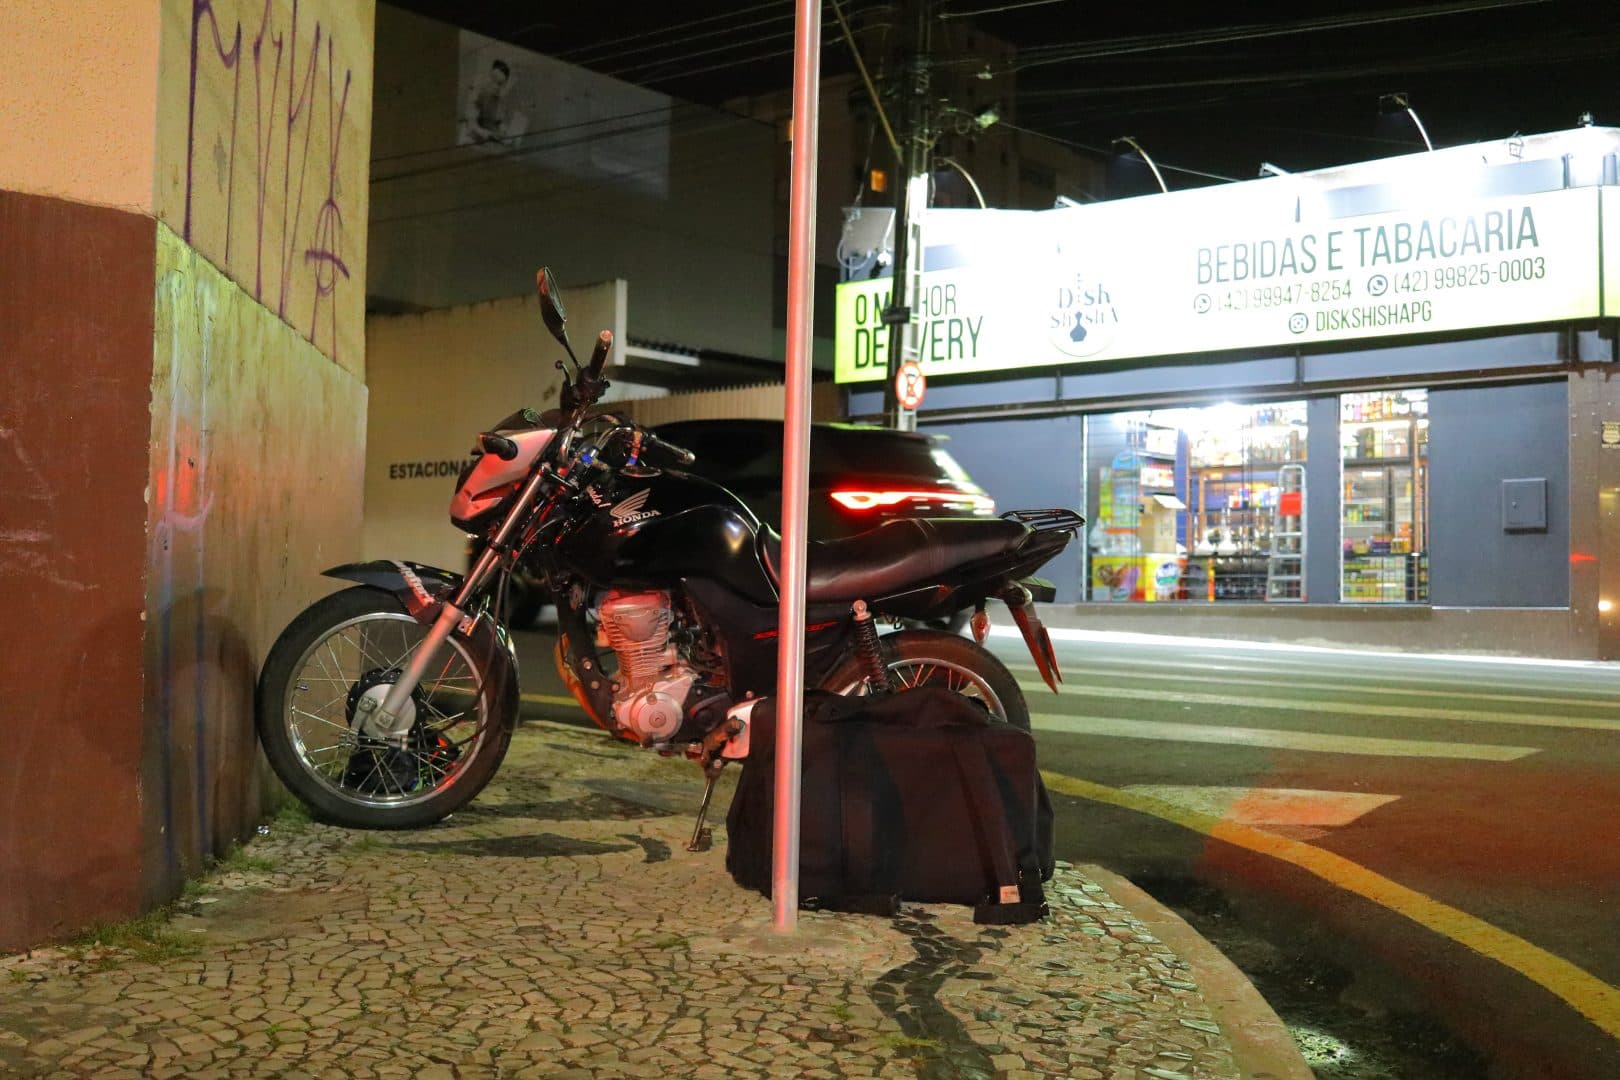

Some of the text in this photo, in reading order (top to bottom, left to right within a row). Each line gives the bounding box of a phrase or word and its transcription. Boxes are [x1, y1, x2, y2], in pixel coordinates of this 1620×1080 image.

[1197, 206, 1540, 285] BEBIDAS E TABACARIA
[855, 284, 957, 325] O MHOR
[1252, 279, 1352, 309] 99947-8254
[1394, 270, 1428, 294] (42)
[1434, 256, 1546, 290] 99825-0003
[1315, 300, 1433, 332] DISKSHISHAPG
[854, 315, 983, 370] DEVERY
[612, 509, 662, 528] HONDA
